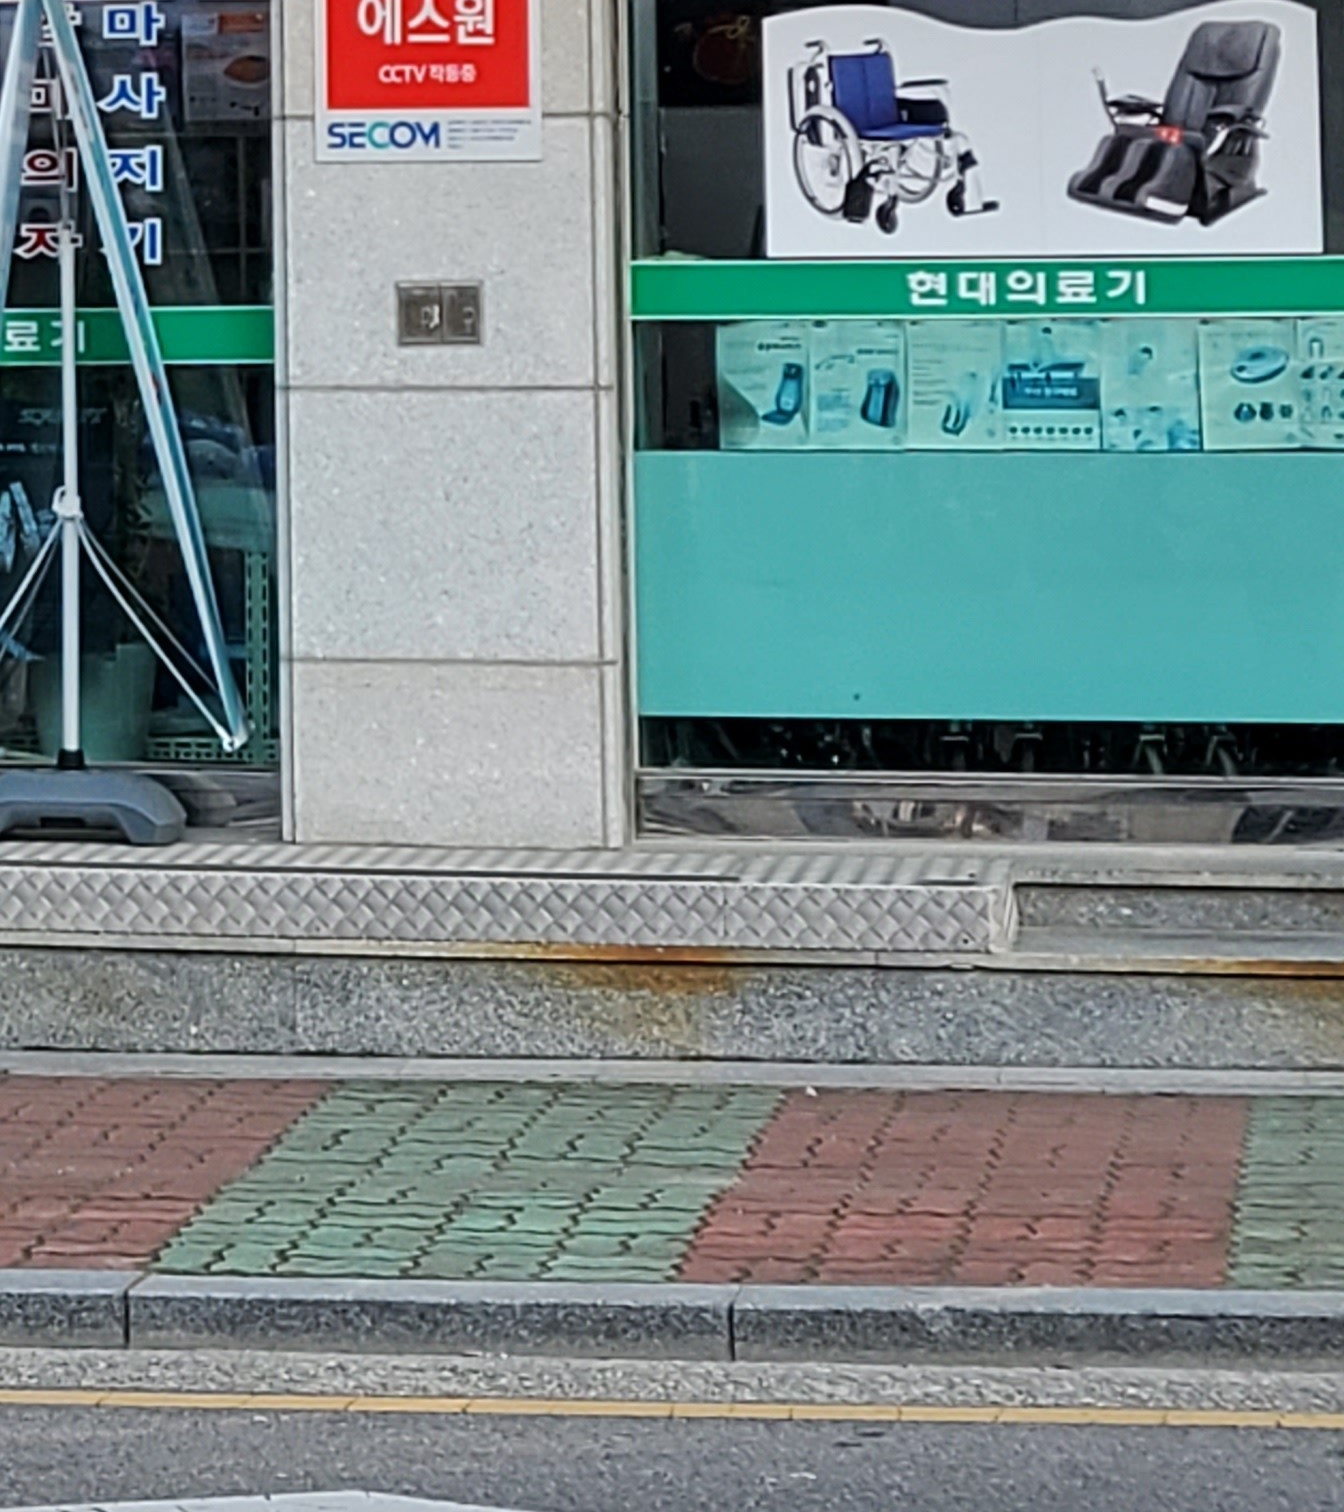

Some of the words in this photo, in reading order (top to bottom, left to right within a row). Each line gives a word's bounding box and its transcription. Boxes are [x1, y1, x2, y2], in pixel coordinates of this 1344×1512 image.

[378, 64, 426, 84] CCTV
[327, 120, 441, 149] SECOM
[905, 269, 1149, 307] 현대의료기
